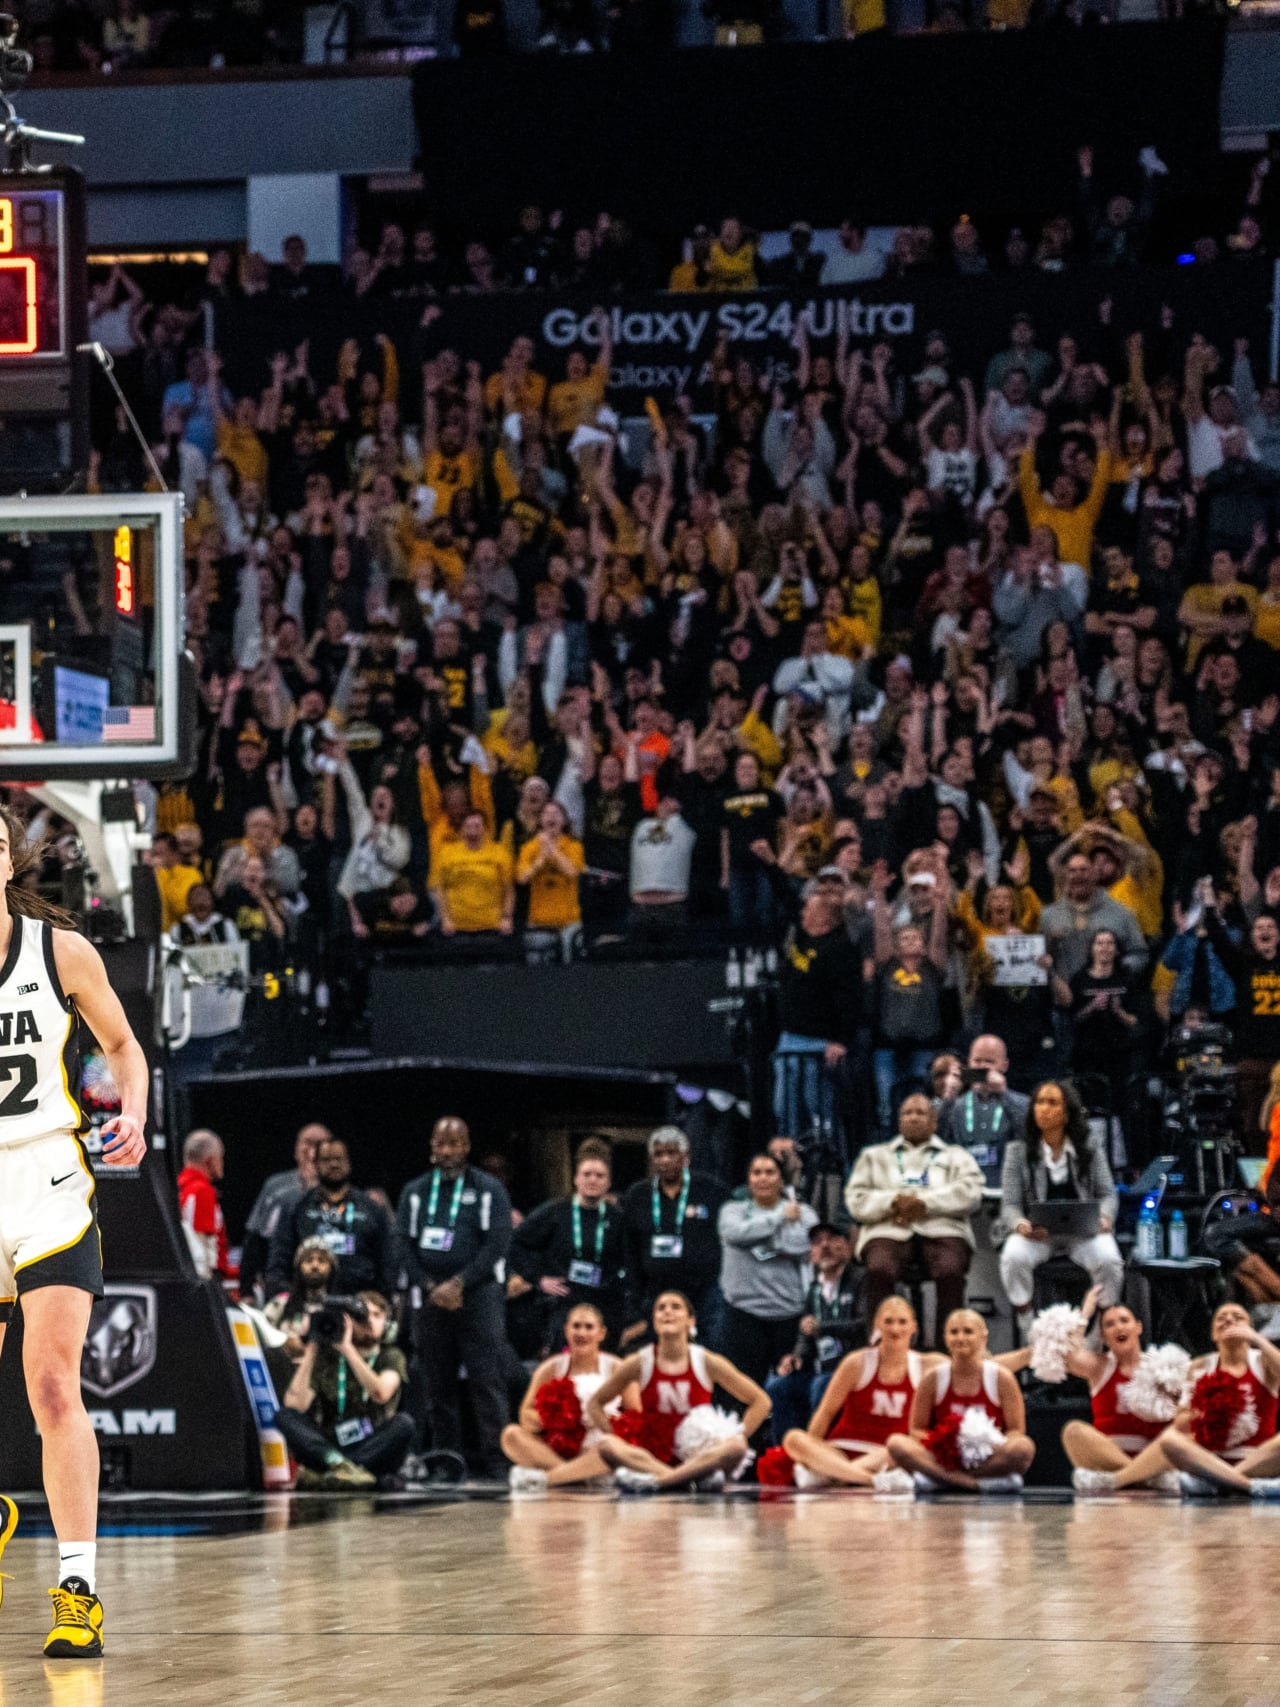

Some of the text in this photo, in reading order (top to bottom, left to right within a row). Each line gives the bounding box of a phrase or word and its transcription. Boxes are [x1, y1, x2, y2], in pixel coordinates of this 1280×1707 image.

[542, 298, 915, 352] Galaxy S24 Ultra
[607, 361, 692, 396] alaxy
[656, 1380, 691, 1415] N
[871, 1389, 907, 1419] N
[35, 1409, 176, 1434] AM
